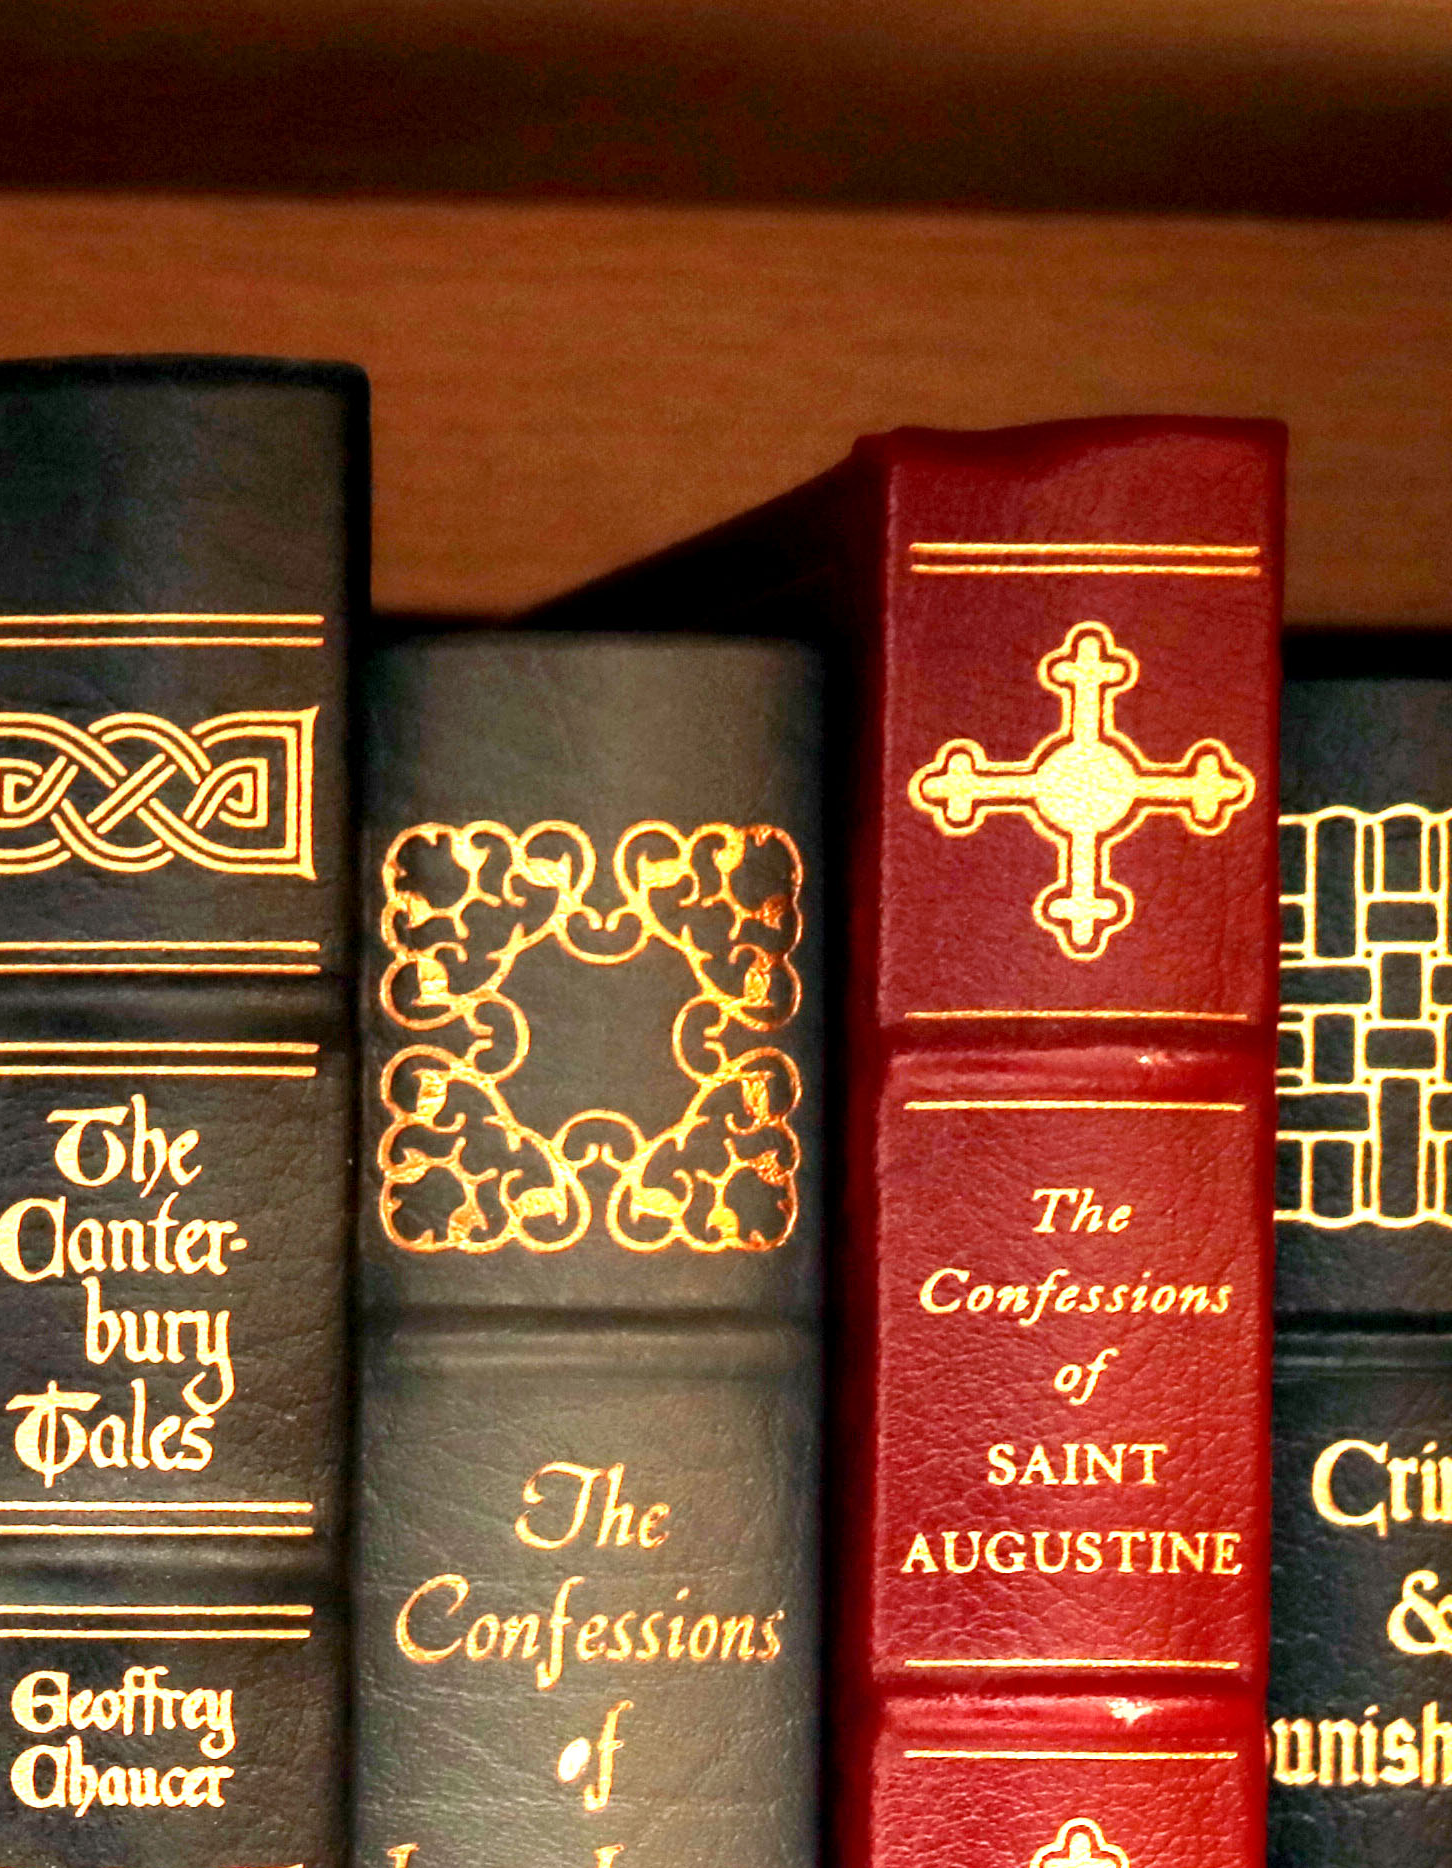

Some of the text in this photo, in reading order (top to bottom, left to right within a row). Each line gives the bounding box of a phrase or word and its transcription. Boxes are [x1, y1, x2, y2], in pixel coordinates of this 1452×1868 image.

[44, 1093, 205, 1198] The
[1030, 1185, 1134, 1236] The
[84, 1275, 236, 1407] bury
[917, 1265, 1235, 1328] Confessions
[1051, 1345, 1112, 1406] of
[4, 1378, 216, 1489] Tales
[985, 1441, 1170, 1488] SAINT
[513, 1459, 672, 1552] The
[898, 1528, 1245, 1578] AUGUSTINE
[393, 1571, 783, 1693] Confessions
[1385, 1567, 1452, 1657] &
[9, 1663, 238, 1758] Geoffrey
[555, 1697, 636, 1814] of
[1264, 1699, 1452, 1790] unish
[8, 1737, 238, 1820] Chaucer
